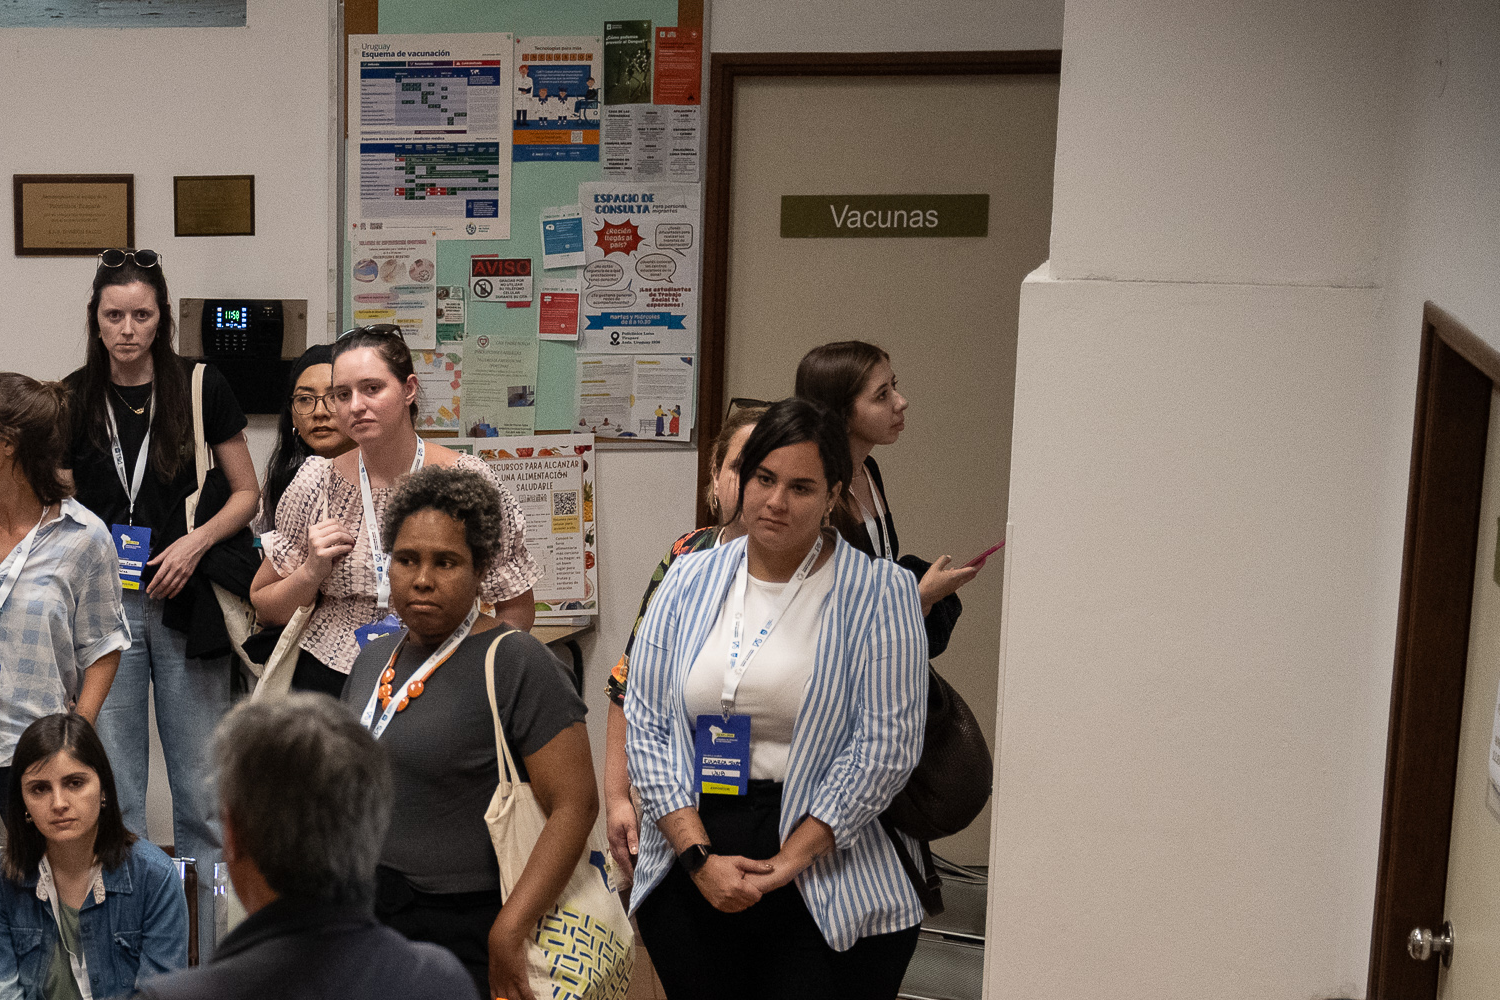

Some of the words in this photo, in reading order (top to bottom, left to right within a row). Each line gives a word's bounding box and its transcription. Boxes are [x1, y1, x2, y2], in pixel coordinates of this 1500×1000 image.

[361, 51, 395, 59] Esquema
[594, 193, 639, 203] ESPACIO
[641, 193, 655, 202] DE
[595, 205, 650, 214] CONSULTA
[830, 204, 938, 228] Vacunas
[473, 260, 530, 275] AVISO
[225, 310, 240, 320] 11:58
[544, 461, 579, 469] ALCANZAR
[517, 471, 567, 480] ALIMENTACIÓN
[516, 483, 553, 491] SALUDABLE
